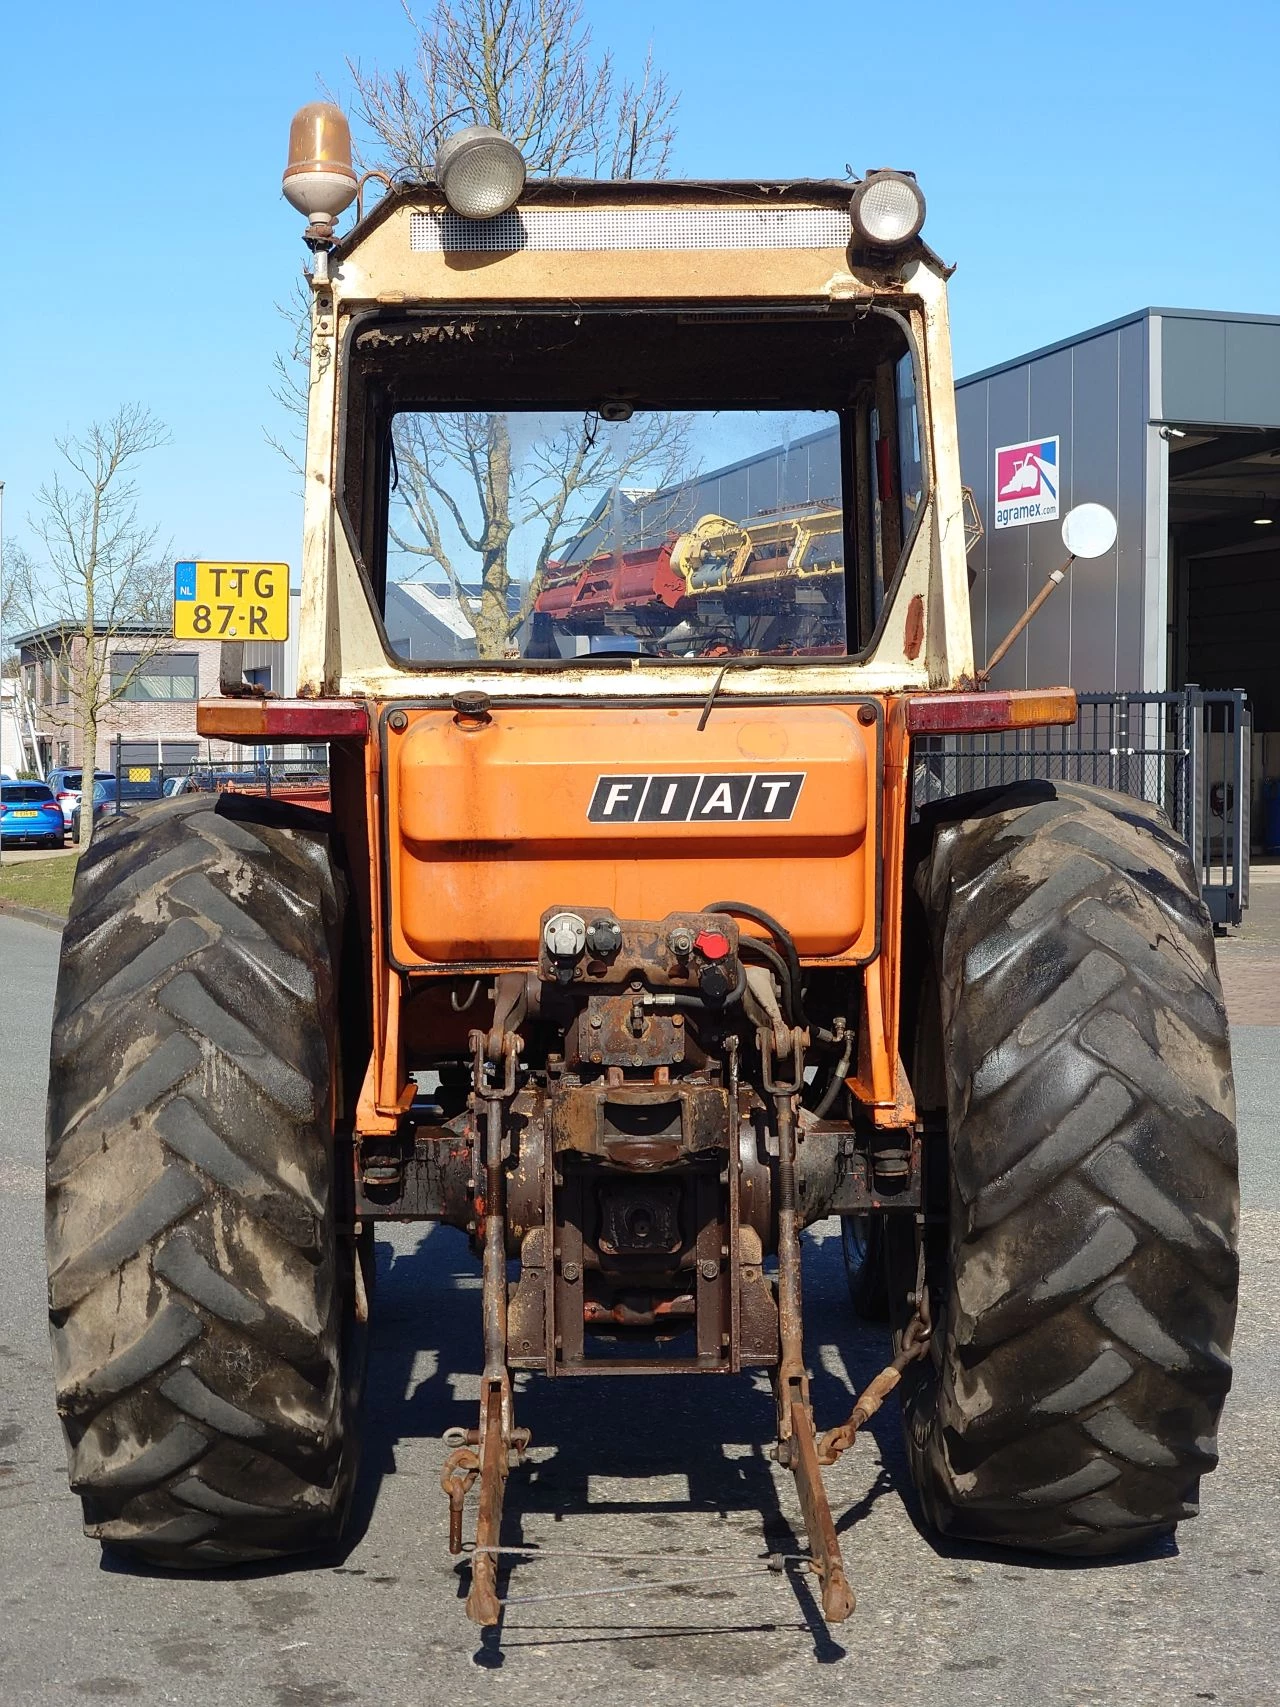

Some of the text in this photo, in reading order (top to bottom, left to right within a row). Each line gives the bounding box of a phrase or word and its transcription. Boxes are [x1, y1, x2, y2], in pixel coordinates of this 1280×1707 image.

[997, 503, 1056, 525] agramex.com
[180, 586, 192, 595] NL
[209, 568, 274, 598] TTG
[193, 604, 268, 635] 87-R
[603, 781, 791, 815] FIAT
